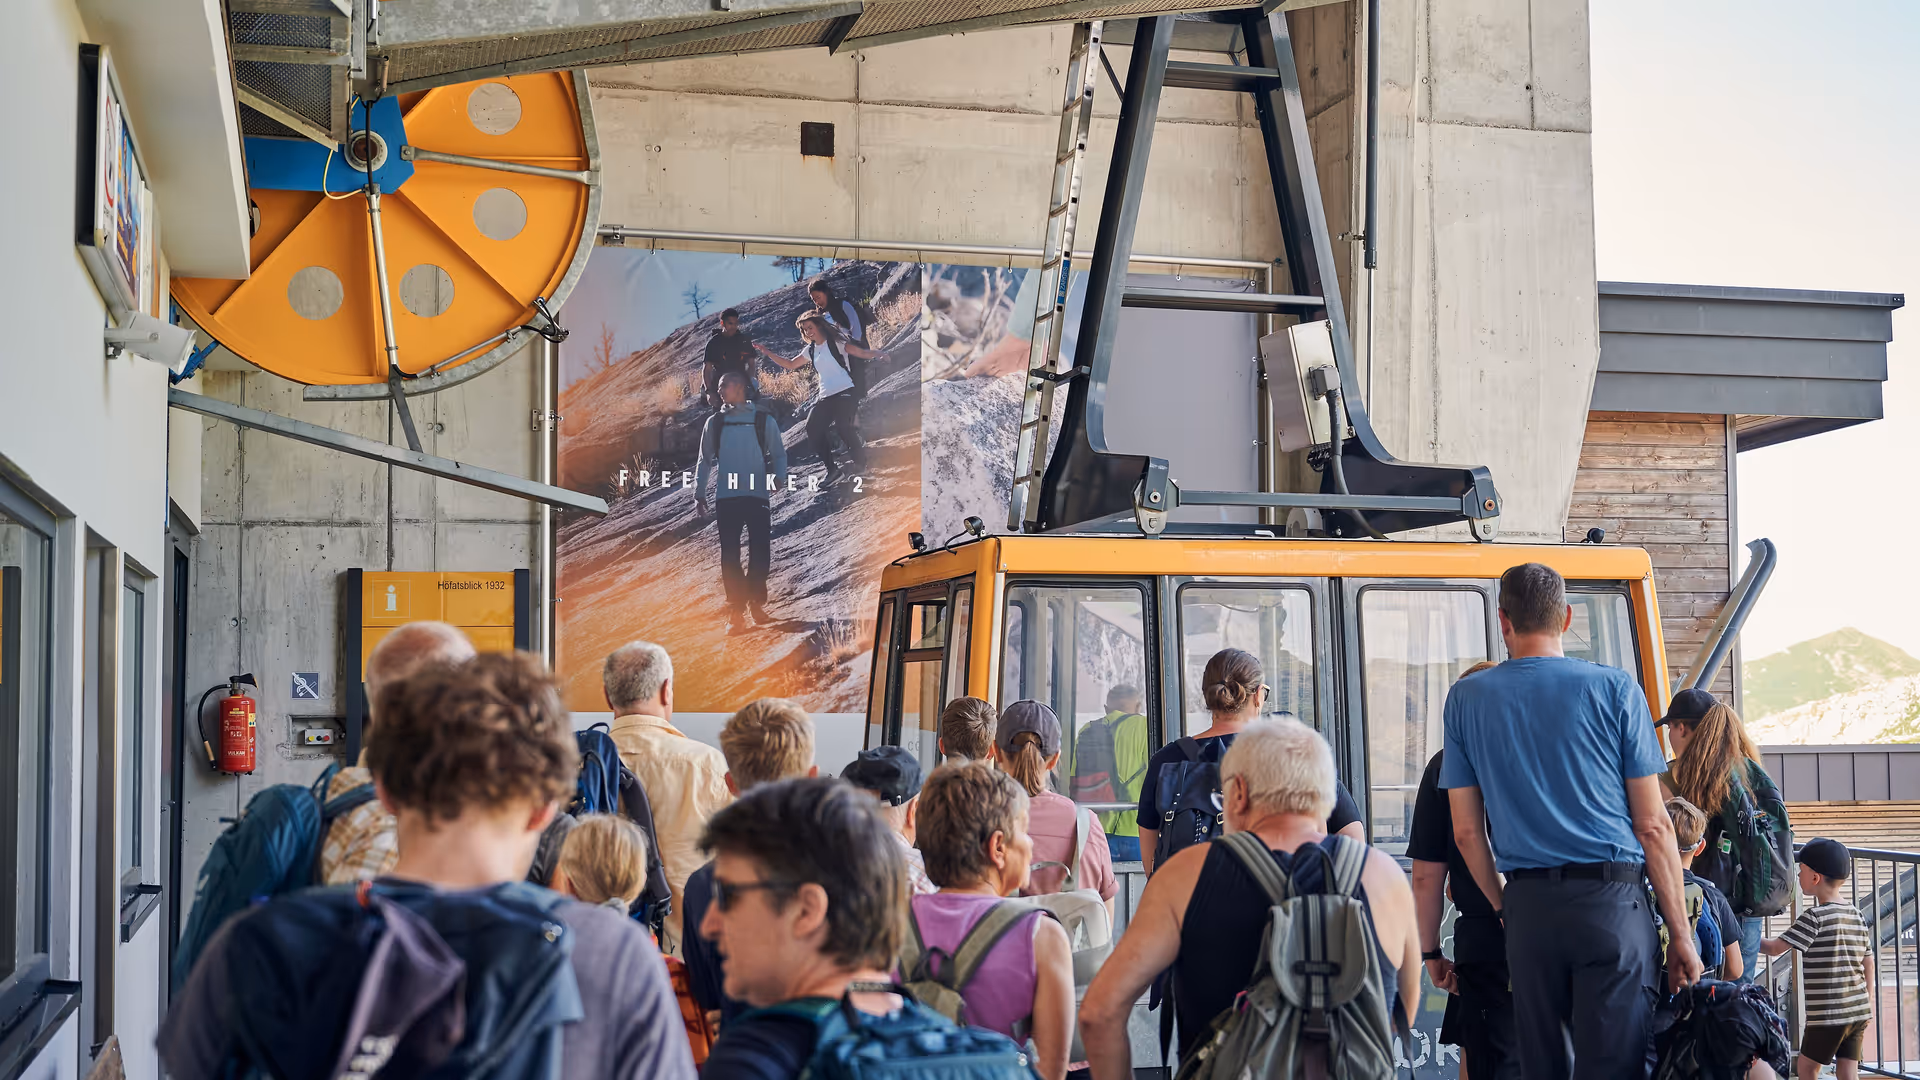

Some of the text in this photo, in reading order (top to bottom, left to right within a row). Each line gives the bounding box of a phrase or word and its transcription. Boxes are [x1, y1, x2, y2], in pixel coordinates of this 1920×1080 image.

[619, 469, 863, 493] FREE HIKER 2
[437, 580, 505, 590] Höfatsblick 1932
